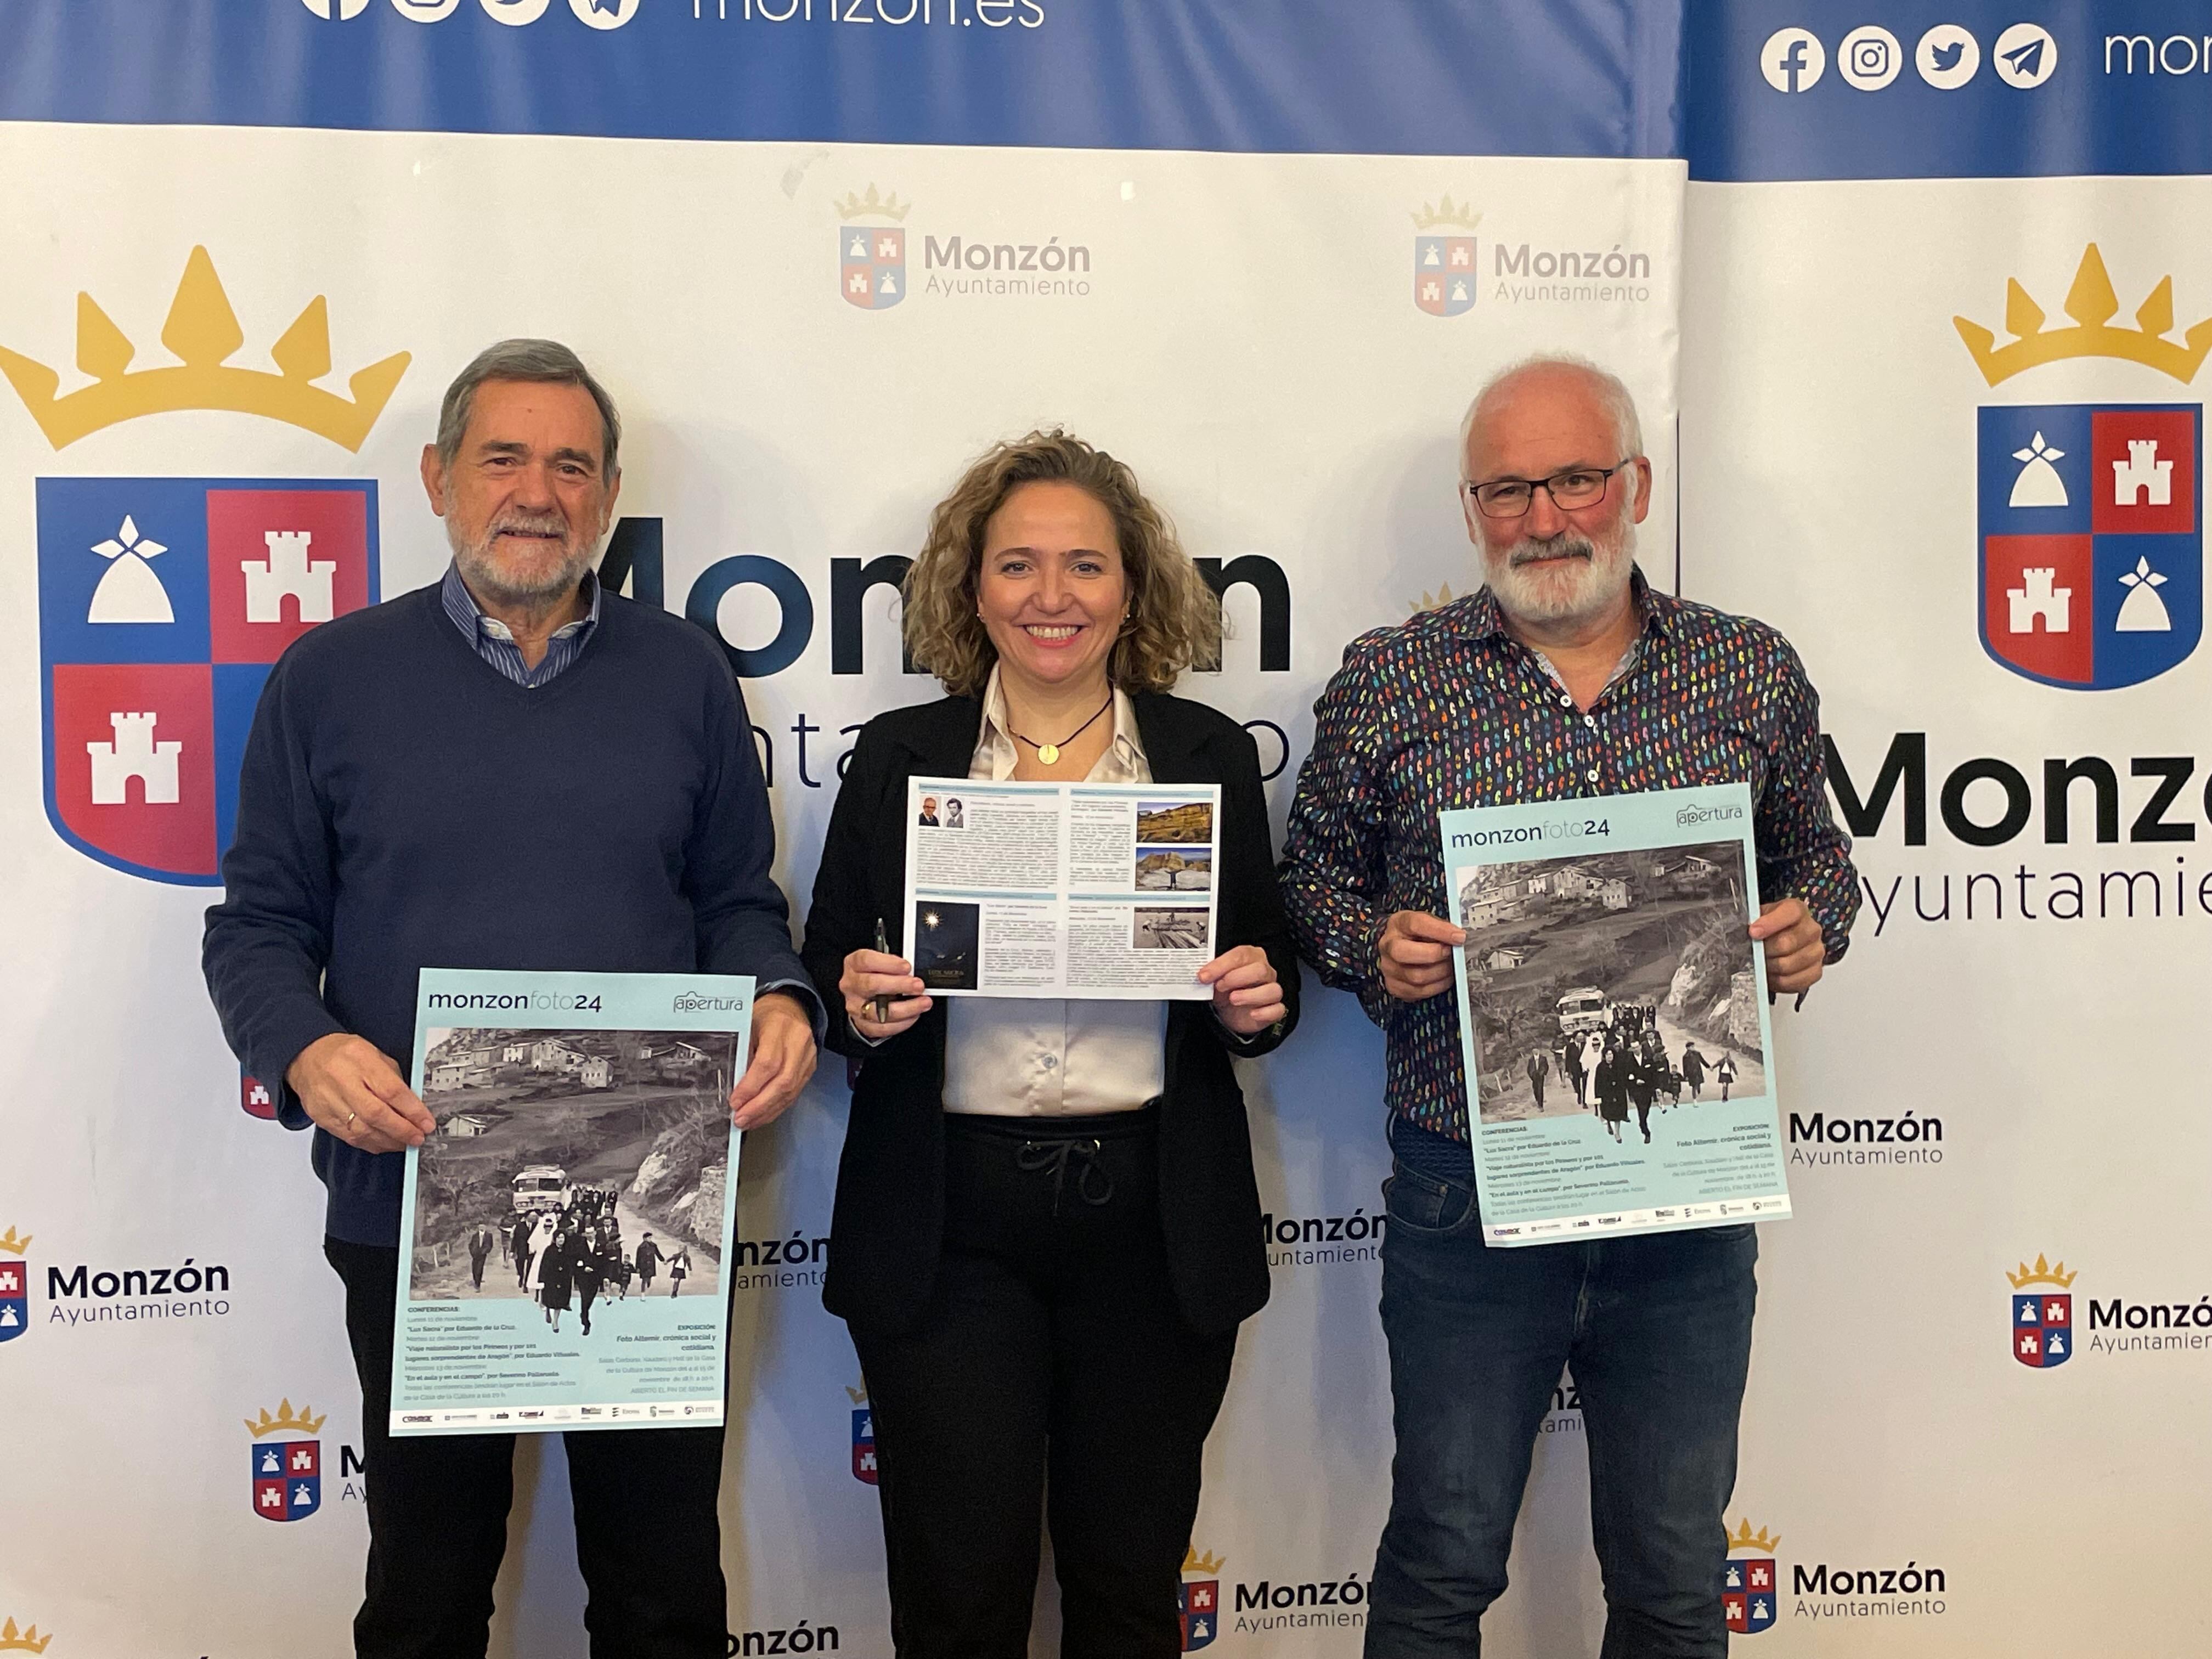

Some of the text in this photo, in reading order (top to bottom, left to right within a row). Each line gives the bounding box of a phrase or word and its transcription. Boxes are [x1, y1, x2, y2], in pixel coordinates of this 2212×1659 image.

[2104, 36, 2212, 75] mo
[924, 235, 1090, 272] Monzón
[1494, 244, 1650, 278] Monzón
[925, 274, 1090, 298] Ayuntamiento
[1494, 281, 1650, 304] Ayuntamiento
[1820, 731, 2212, 847] Monz
[1678, 805, 1742, 827] apertura
[1452, 819, 1610, 848] monzonfoto24
[1862, 856, 2212, 936] yuntami
[428, 990, 602, 1013] monzonfoto24
[674, 992, 743, 1013] apertura
[1789, 1111, 1943, 1143] Monzón
[1790, 1146, 1943, 1169] Ayuntamiento
[737, 1230, 831, 1266] nzón
[1268, 1245, 1383, 1266] untamient
[47, 1258, 229, 1300] Monzón
[737, 1269, 826, 1290] amient
[49, 1299, 230, 1327] Ayuntamiento
[1235, 1573, 1372, 1612] Monzó
[1793, 1561, 1946, 1595] Monzón
[1234, 1610, 1363, 1634] Ayuntamien
[1794, 1599, 1946, 1621] Ayuntamiento
[727, 1620, 839, 1658] nzón
